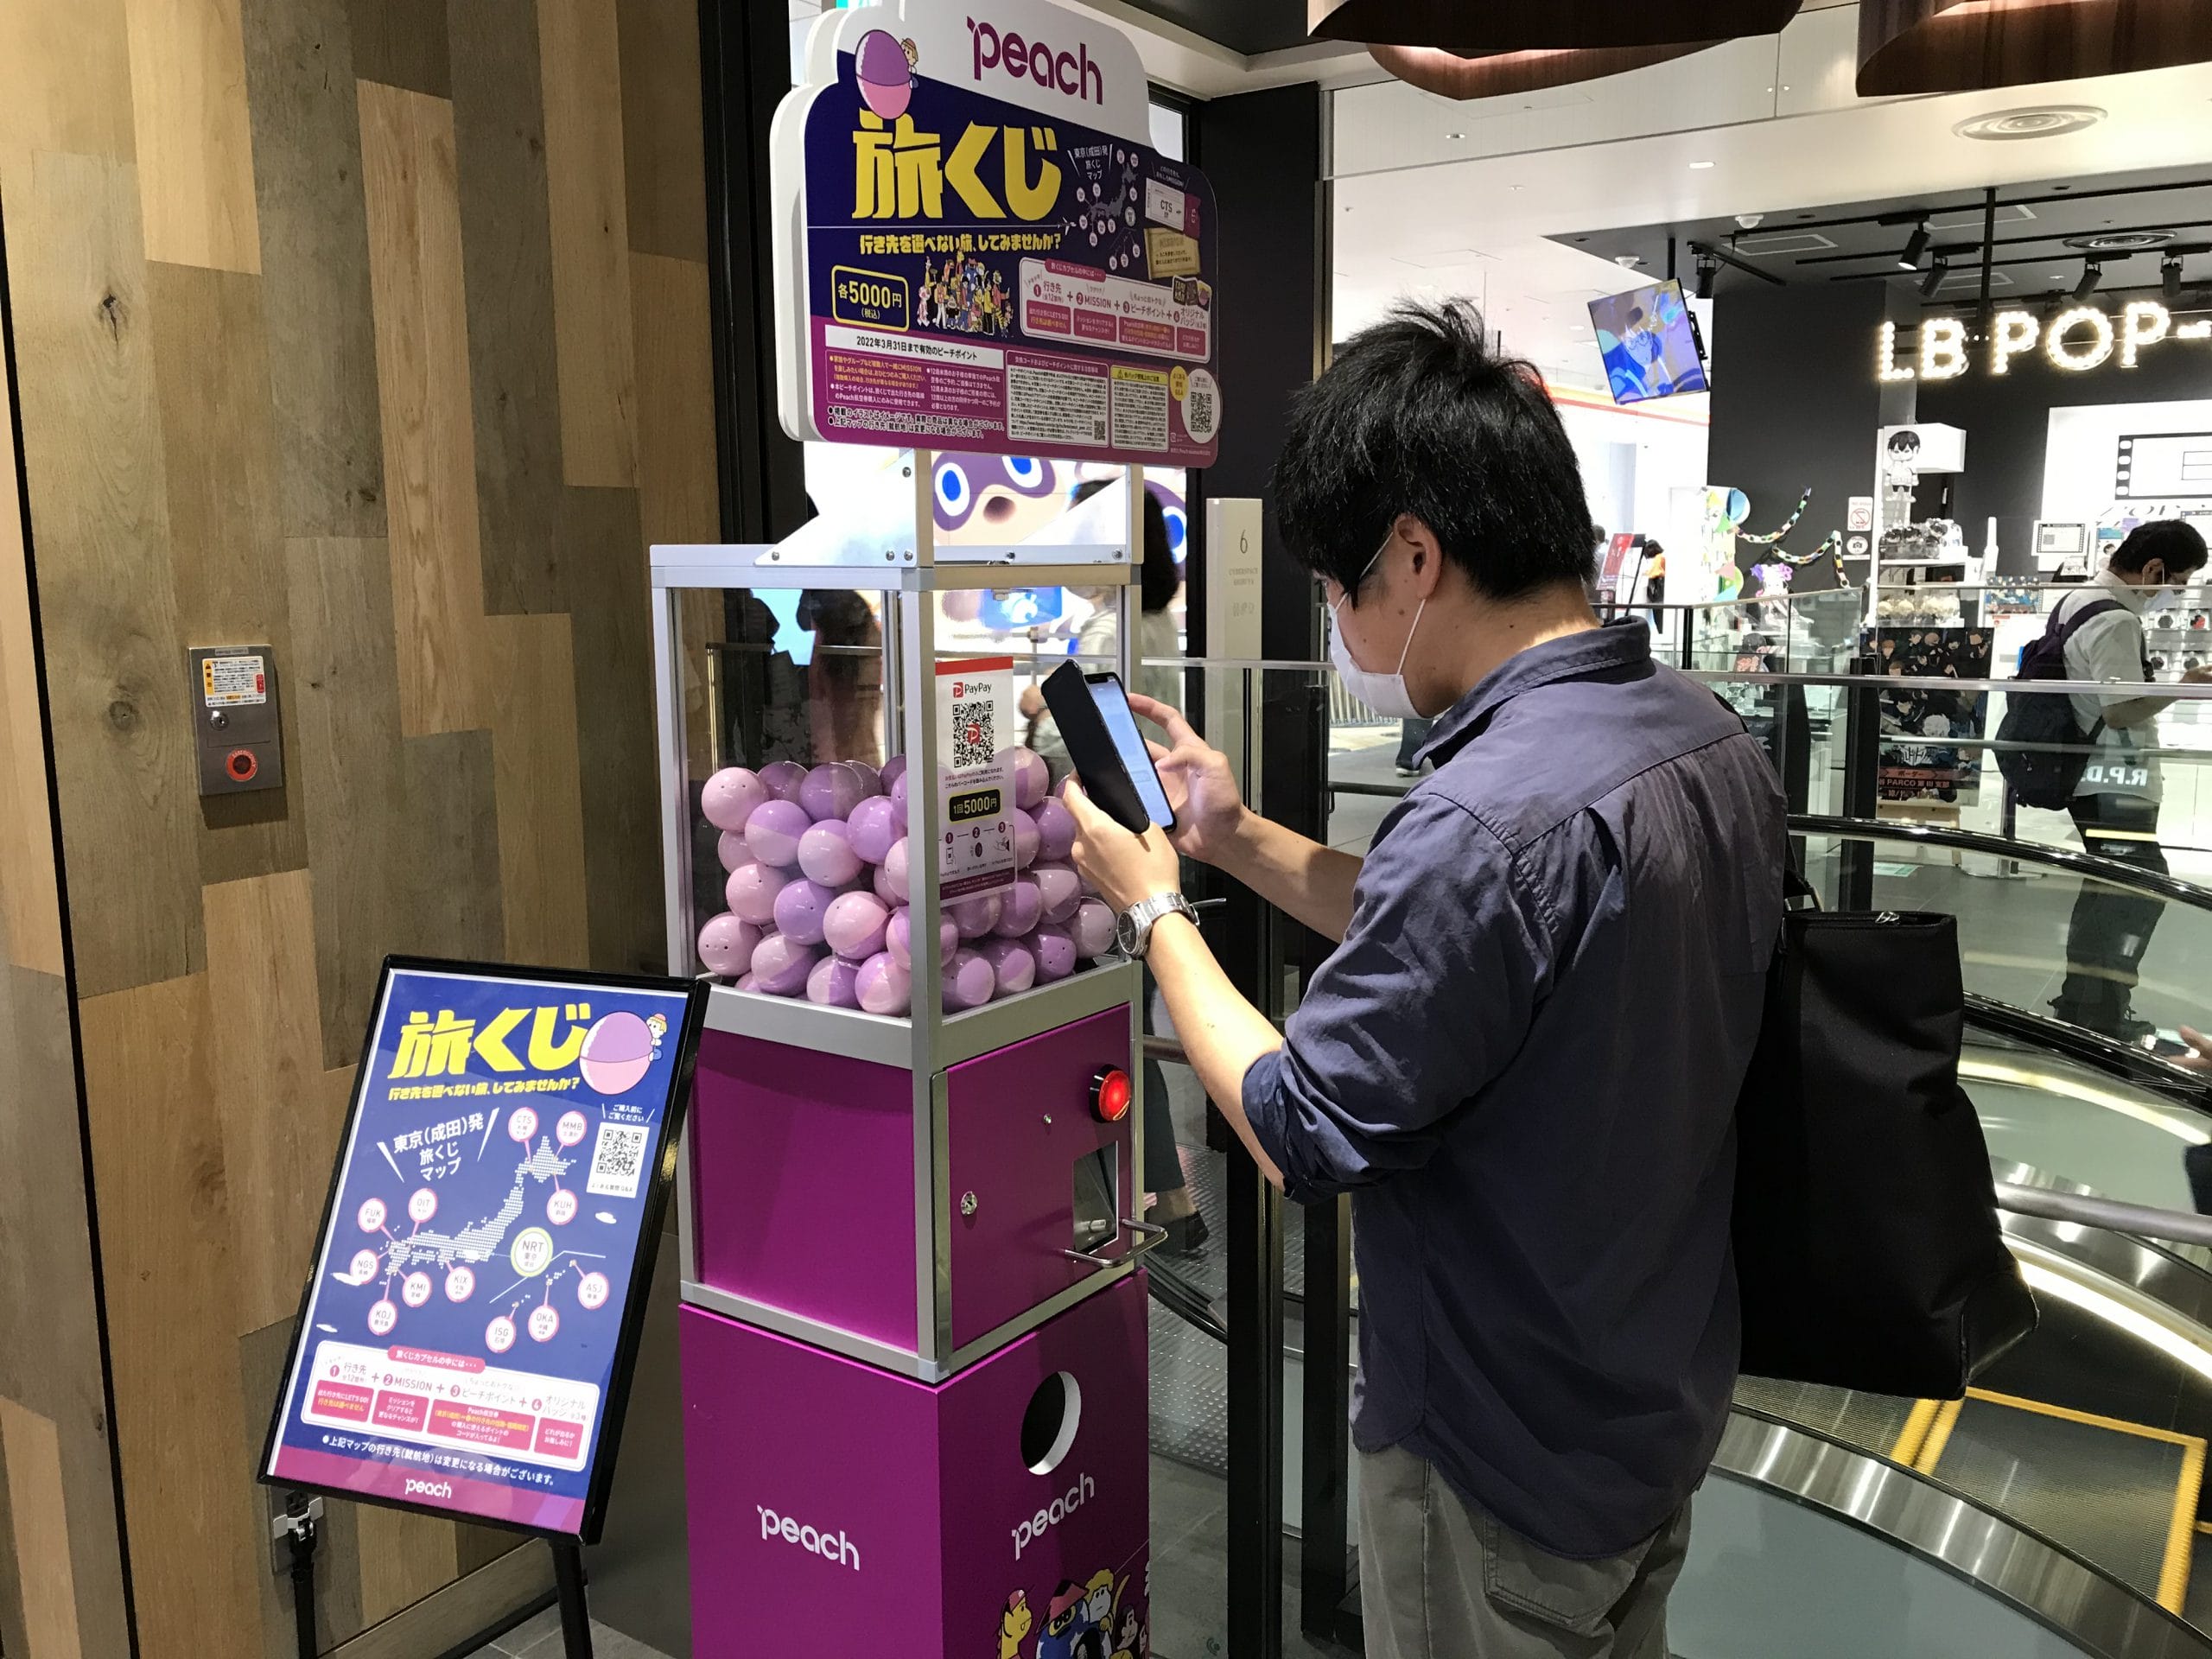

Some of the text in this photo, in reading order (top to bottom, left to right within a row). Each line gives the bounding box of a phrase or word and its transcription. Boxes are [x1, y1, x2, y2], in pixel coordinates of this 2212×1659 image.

[966, 16, 1103, 105] peach
[851, 107, 1062, 221] 旅くじ
[838, 280, 902, 308] 各5000円
[1043, 281, 1062, 294] 行き先
[1084, 296, 1111, 308] MISSION
[861, 308, 880, 320] (税込)
[856, 336, 977, 361] 2022年3月31日まで有効のピーチポイント
[1878, 317, 1970, 381] LB
[1240, 530, 1248, 554] 6
[964, 682, 992, 694] PayPay
[953, 796, 997, 815] 1回5000円
[387, 1003, 591, 1079] 旅くじ
[517, 1116, 532, 1124] CTS
[562, 1122, 583, 1131] MMB
[393, 1112, 484, 1154] 東京(成田)発
[419, 1141, 460, 1166] 旅くじ
[420, 1157, 461, 1181] マップ
[416, 1198, 430, 1207] OIT
[365, 1208, 382, 1217] FUK
[522, 1240, 544, 1252] NRT
[357, 1260, 373, 1268] NGS
[454, 1275, 467, 1284] KIX
[410, 1283, 427, 1292] KMI
[586, 1284, 602, 1294] ASJ
[376, 1310, 391, 1319] KOJ
[536, 1313, 553, 1322] OKA
[495, 1327, 509, 1337] ISG
[344, 1362, 367, 1375] 行き先
[394, 1377, 433, 1392] MISSION
[462, 1389, 516, 1404] ピーチポイント
[545, 1395, 585, 1409] オリジナル
[405, 1478, 452, 1499] peach
[1011, 1472, 1095, 1560] peach
[756, 1503, 860, 1571] peach
